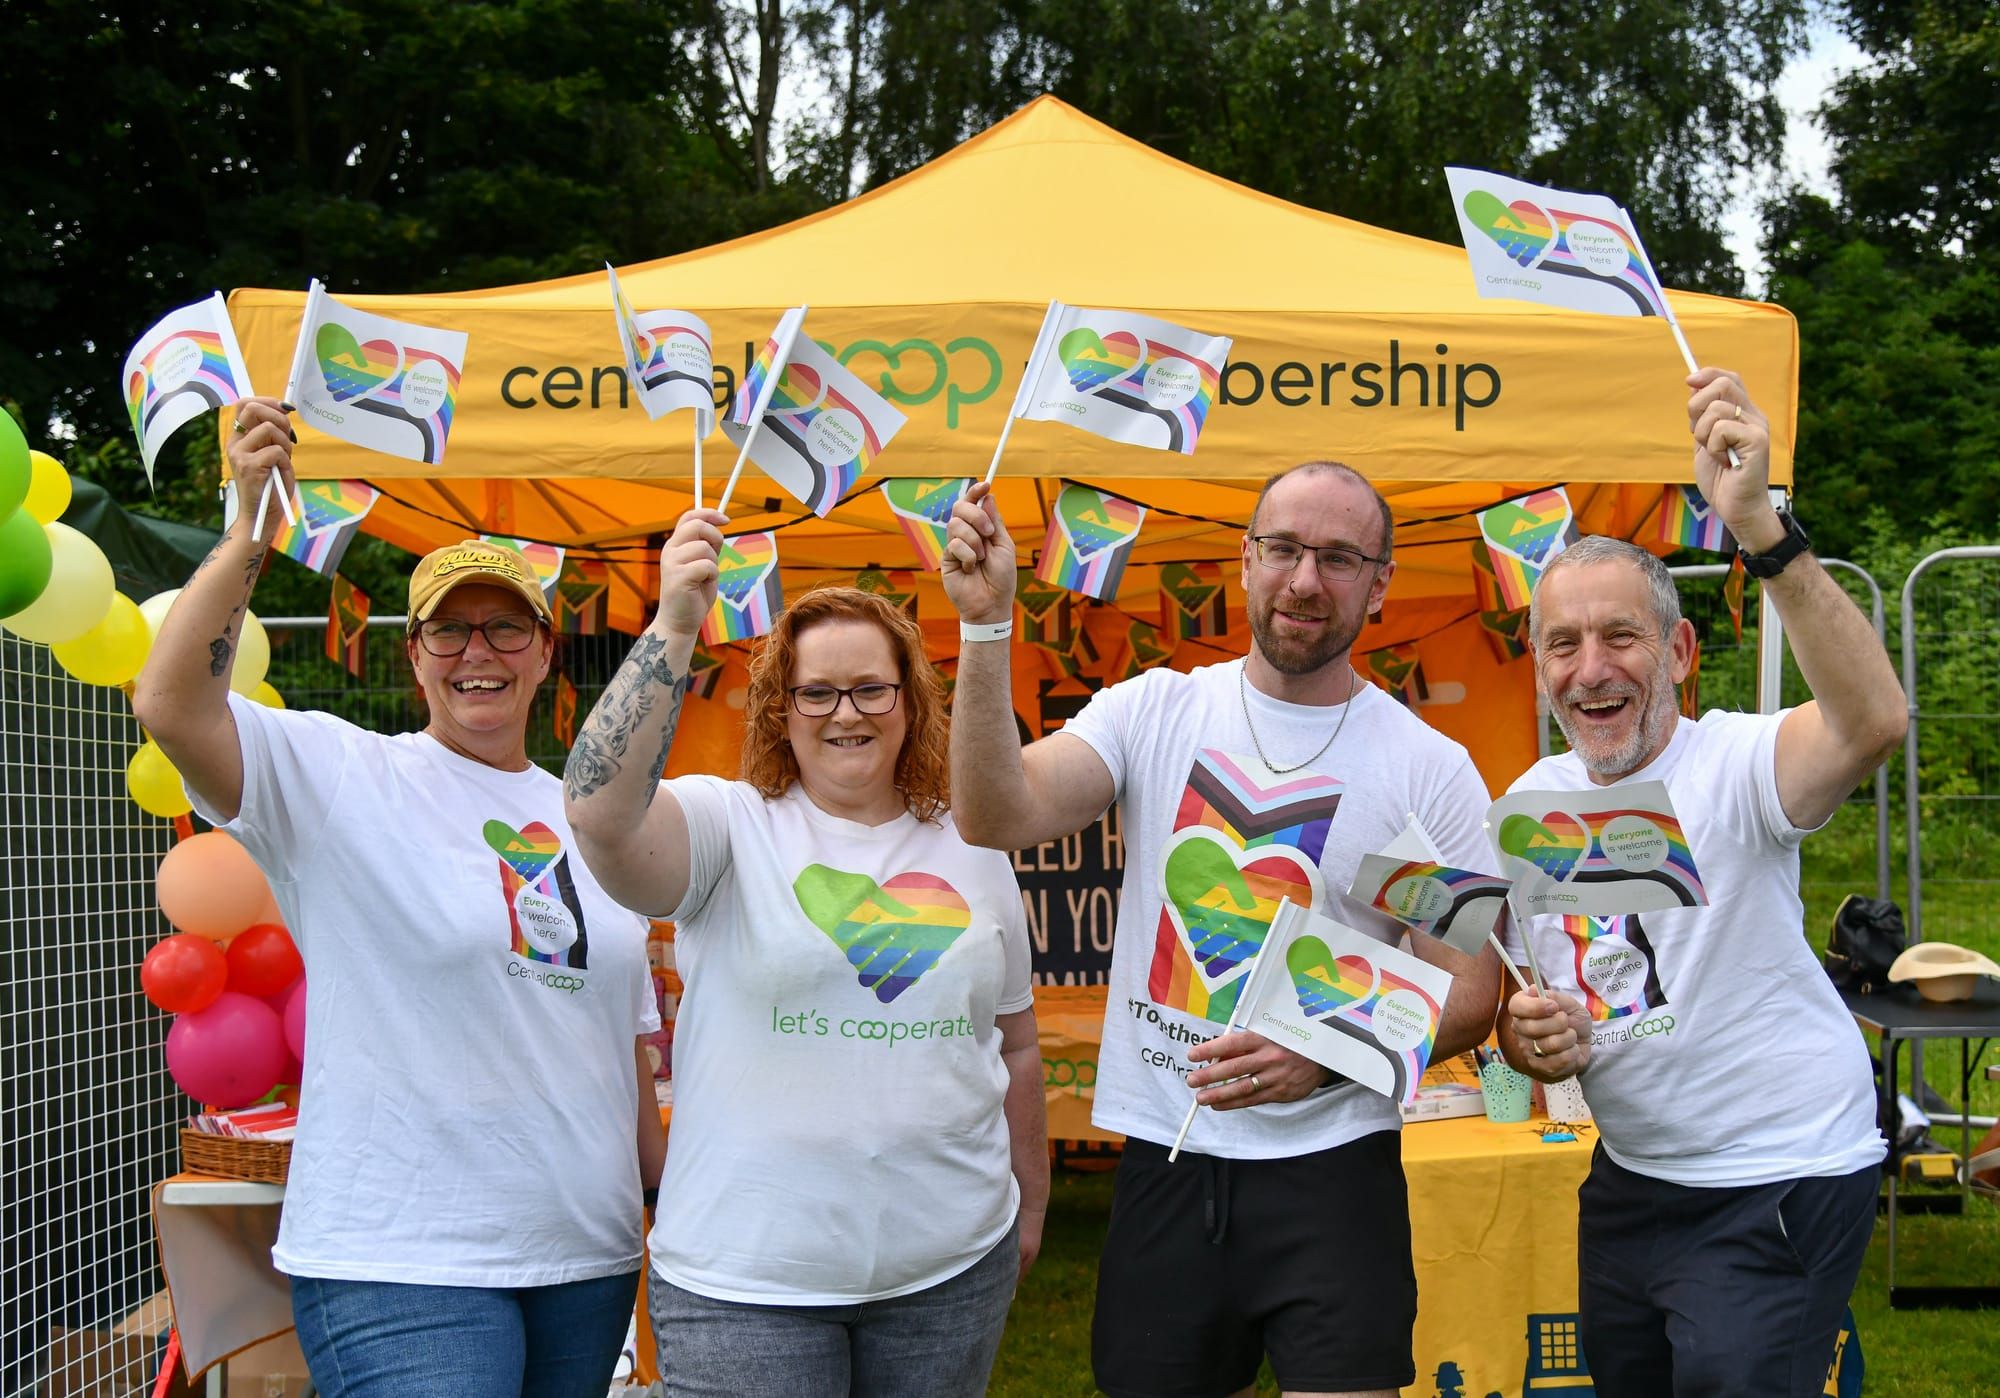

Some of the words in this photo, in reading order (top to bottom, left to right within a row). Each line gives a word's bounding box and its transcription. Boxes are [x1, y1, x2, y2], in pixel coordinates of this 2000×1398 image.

[1582, 245, 1623, 254] welcome
[501, 342, 754, 408] cenal
[815, 337, 1003, 430] oop
[1024, 340, 1501, 431] bership
[1157, 380, 1194, 392] welcome
[413, 385, 443, 398] welcome
[822, 427, 854, 455] welcome
[1617, 840, 1662, 852] welcome
[524, 897, 555, 912] Every
[1386, 1012, 1424, 1035] welcome
